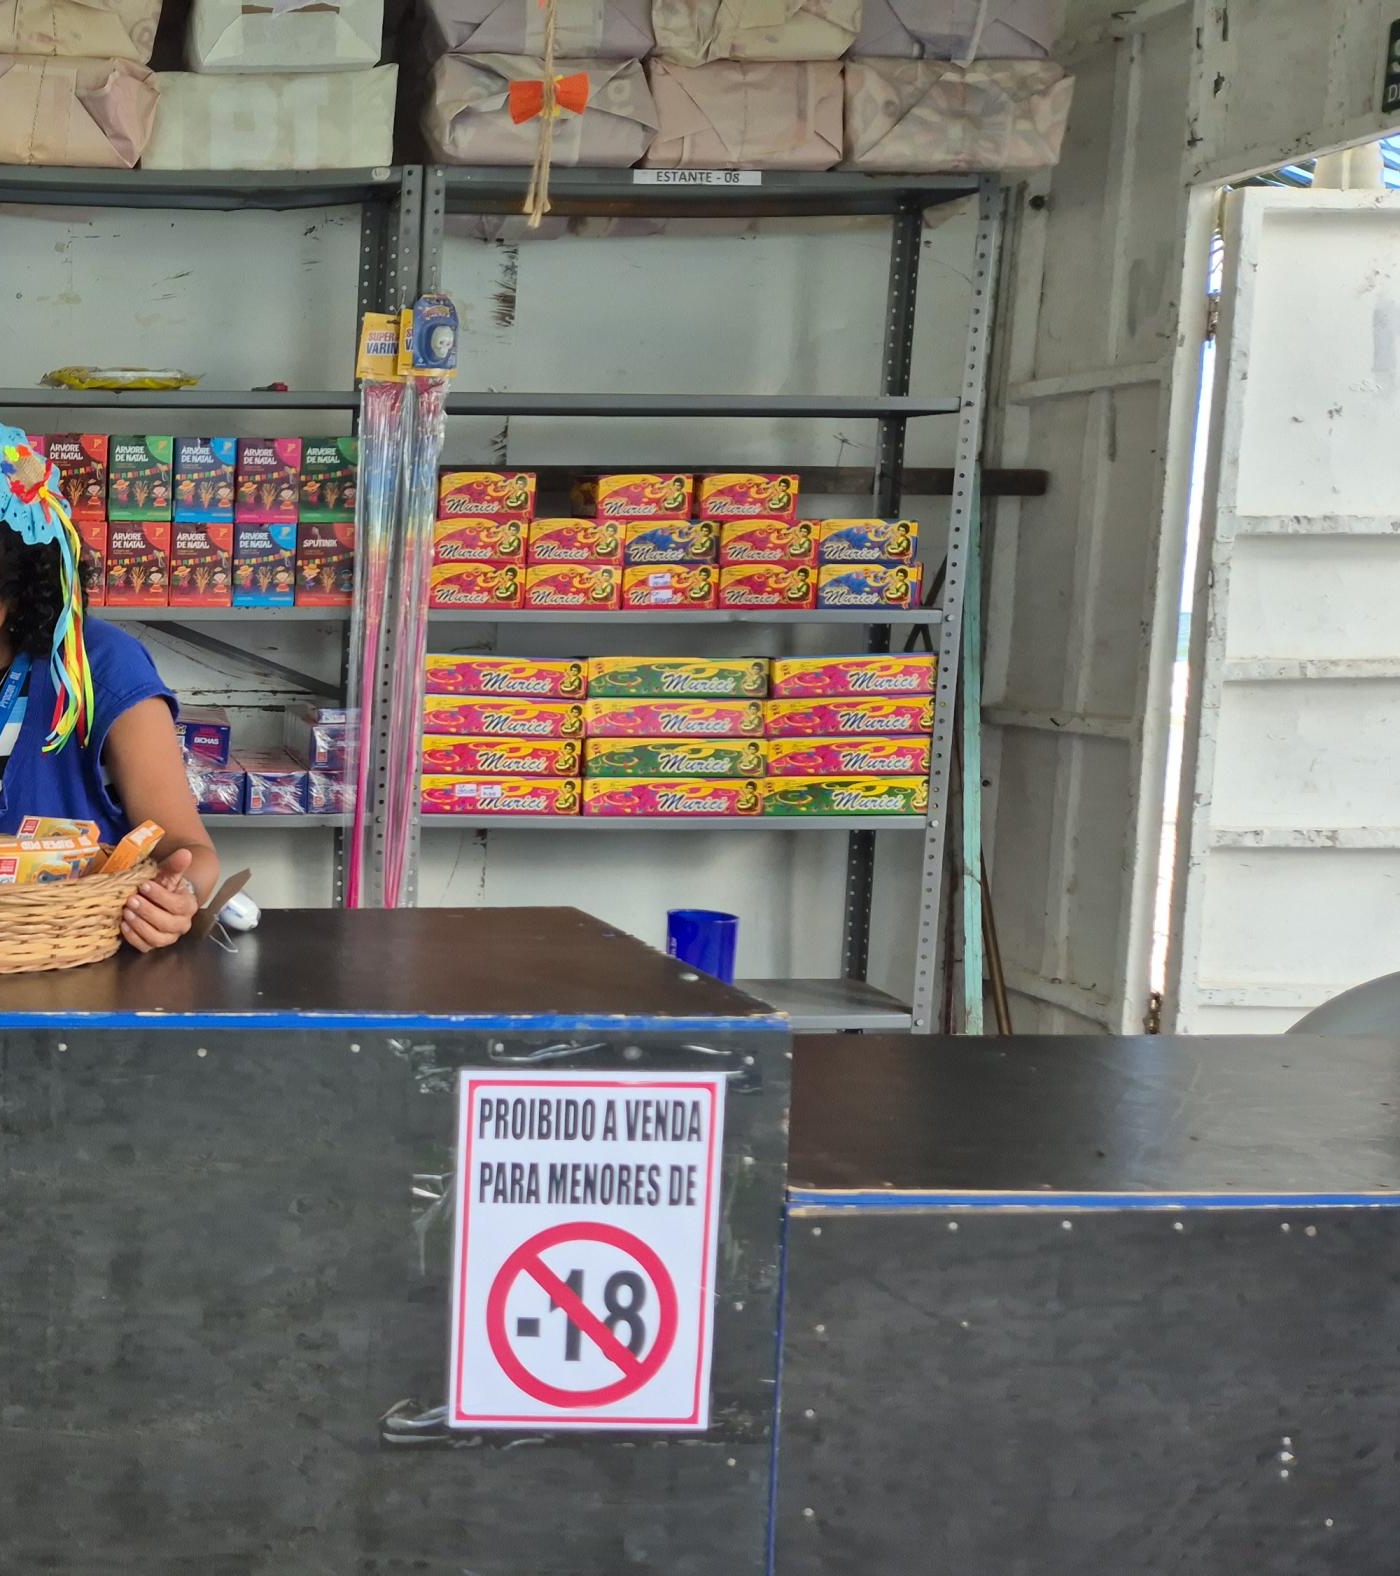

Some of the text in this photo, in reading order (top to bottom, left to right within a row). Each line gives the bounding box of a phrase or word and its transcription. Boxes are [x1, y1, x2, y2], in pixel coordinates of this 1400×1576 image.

[656, 171, 712, 183] ESTANTE
[724, 172, 740, 183] 08
[367, 342, 398, 355] VARIN
[50, 451, 62, 460] DE
[115, 453, 127, 462] DE
[181, 454, 192, 463] DE
[243, 456, 255, 465] DE
[306, 455, 318, 464] DE
[446, 497, 499, 514] Murici
[604, 501, 657, 515] Murici
[708, 500, 762, 514] Murici
[112, 540, 124, 549] DE
[176, 540, 187, 549] DE
[239, 540, 251, 549] DE
[439, 544, 492, 559] Murici
[535, 544, 589, 560] Murici
[824, 544, 880, 559] Murici
[631, 546, 685, 561] Murici
[725, 589, 782, 605] Murici
[480, 672, 550, 693] Murici
[663, 673, 735, 693] Murici
[849, 672, 919, 690] Murici
[483, 713, 552, 734] Murici
[839, 711, 911, 731] Murici
[477, 751, 547, 773] Murici
[658, 753, 729, 773] Murici
[841, 752, 911, 771] Murici
[657, 792, 729, 812] Murici
[832, 790, 904, 810] Murici
[478, 1097, 703, 1142] PROIBIDO A VENDA
[478, 1162, 698, 1207] PARA MENORES DE
